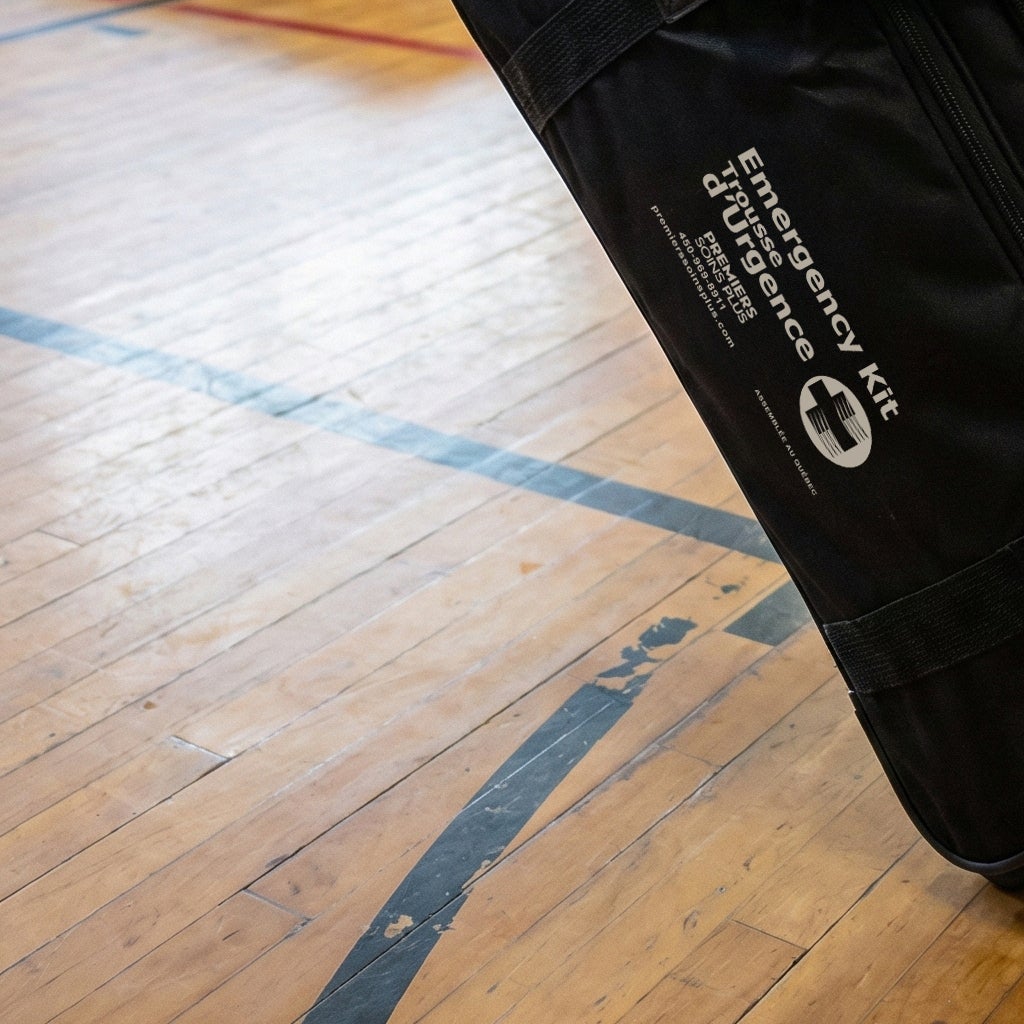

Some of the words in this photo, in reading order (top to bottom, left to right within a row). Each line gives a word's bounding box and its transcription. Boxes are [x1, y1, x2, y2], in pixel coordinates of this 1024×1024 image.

[722, 160, 782, 267] Trousse
[651, 206, 734, 347] premierssoinsplus.com
[679, 232, 726, 310] 450-969-8911
[695, 237, 725, 283] SOINS
[722, 285, 747, 323] PLUS
[703, 174, 814, 361] d'Urgence
[703, 231, 757, 318] PREMIERS
[738, 147, 863, 351] Emergency
[859, 363, 898, 420] Kit
[785, 444, 796, 457] AU
